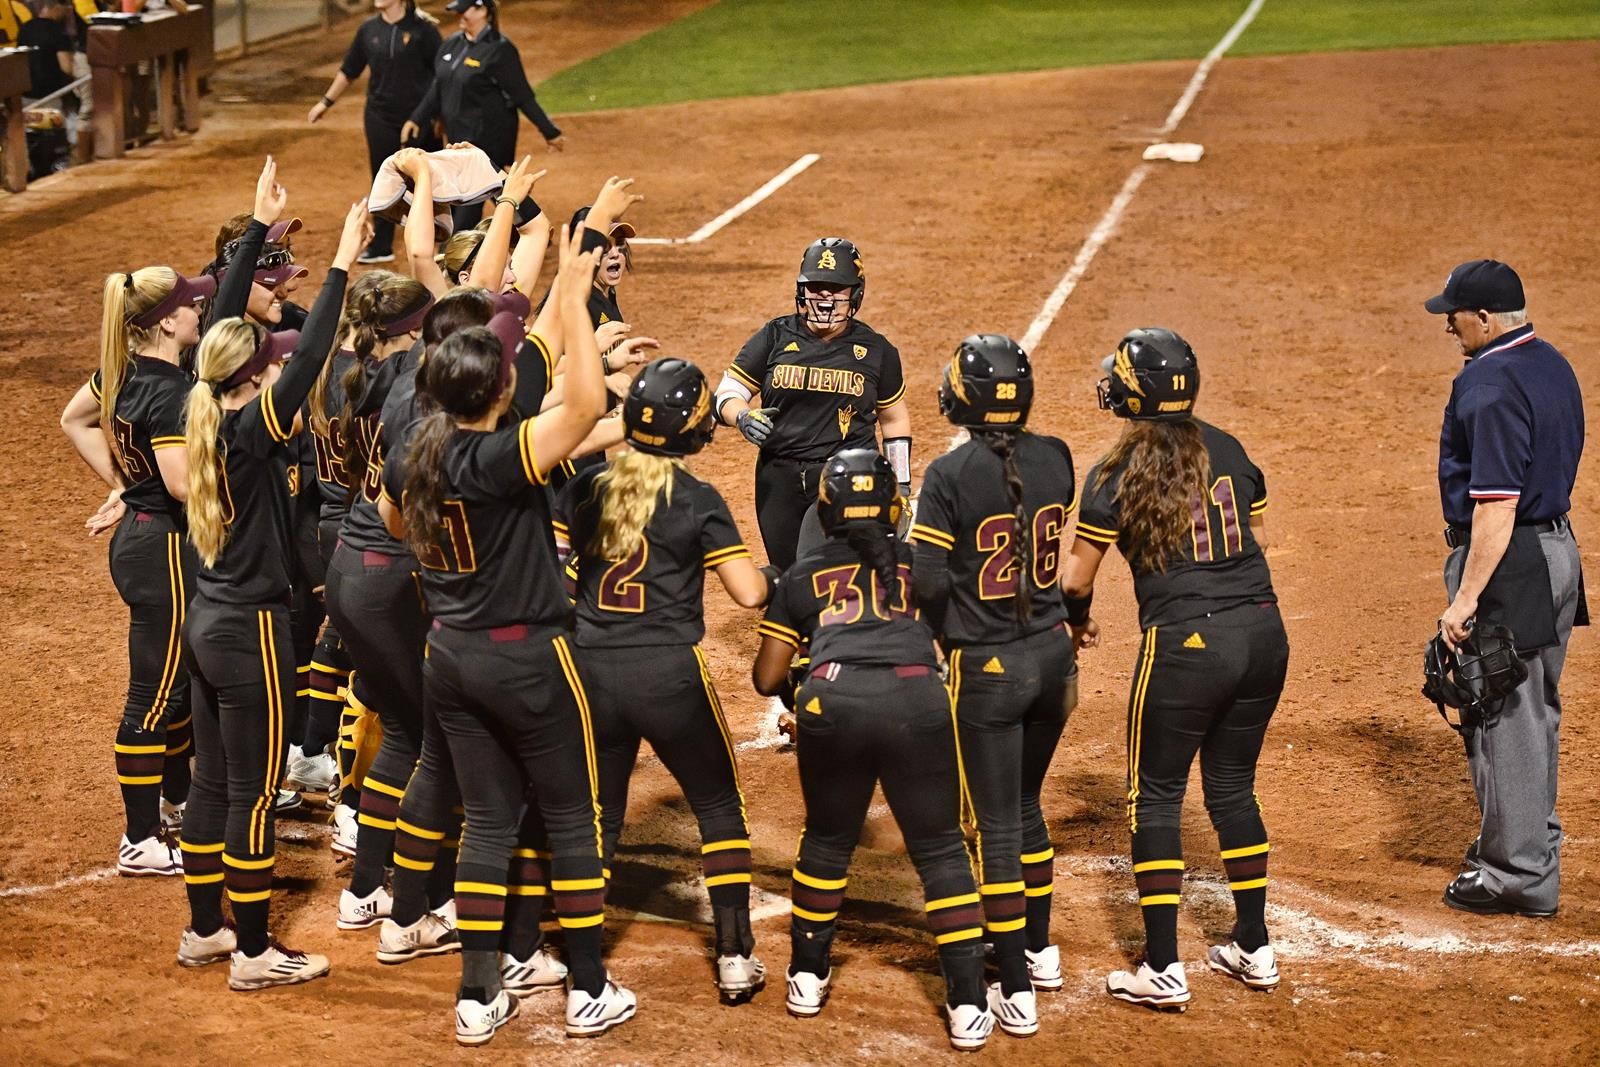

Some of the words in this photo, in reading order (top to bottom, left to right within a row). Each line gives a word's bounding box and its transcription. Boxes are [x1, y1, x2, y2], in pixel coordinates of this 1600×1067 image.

[771, 364, 807, 390] SUN
[808, 367, 865, 396] DEVILS
[996, 382, 1017, 400] 26
[1172, 374, 1186, 391] 11
[641, 406, 654, 424] 2
[851, 475, 874, 492] 30
[1191, 476, 1242, 561] 11
[976, 503, 1066, 600] 26
[599, 534, 649, 612] 2
[812, 563, 919, 627] 30
